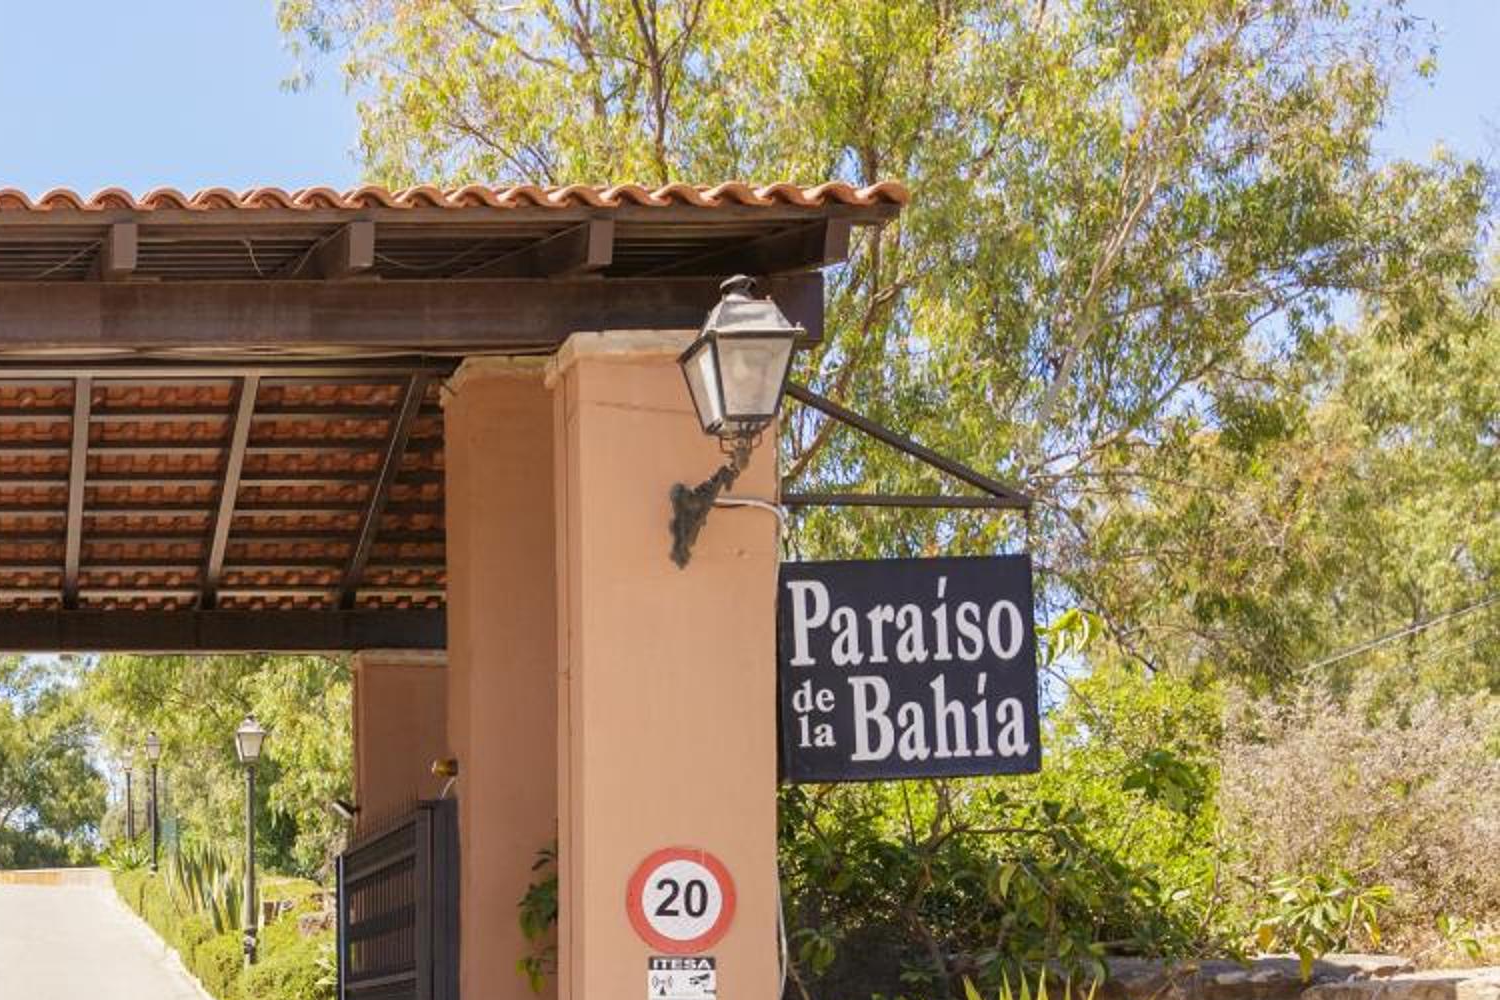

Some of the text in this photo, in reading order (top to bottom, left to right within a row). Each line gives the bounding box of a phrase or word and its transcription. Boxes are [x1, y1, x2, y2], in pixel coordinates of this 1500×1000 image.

[786, 576, 1024, 666] Paraíso
[792, 679, 836, 712] de
[798, 716, 836, 747] la
[847, 672, 1030, 761] Bahía
[654, 878, 709, 918] 20
[653, 959, 712, 970] ITESA
